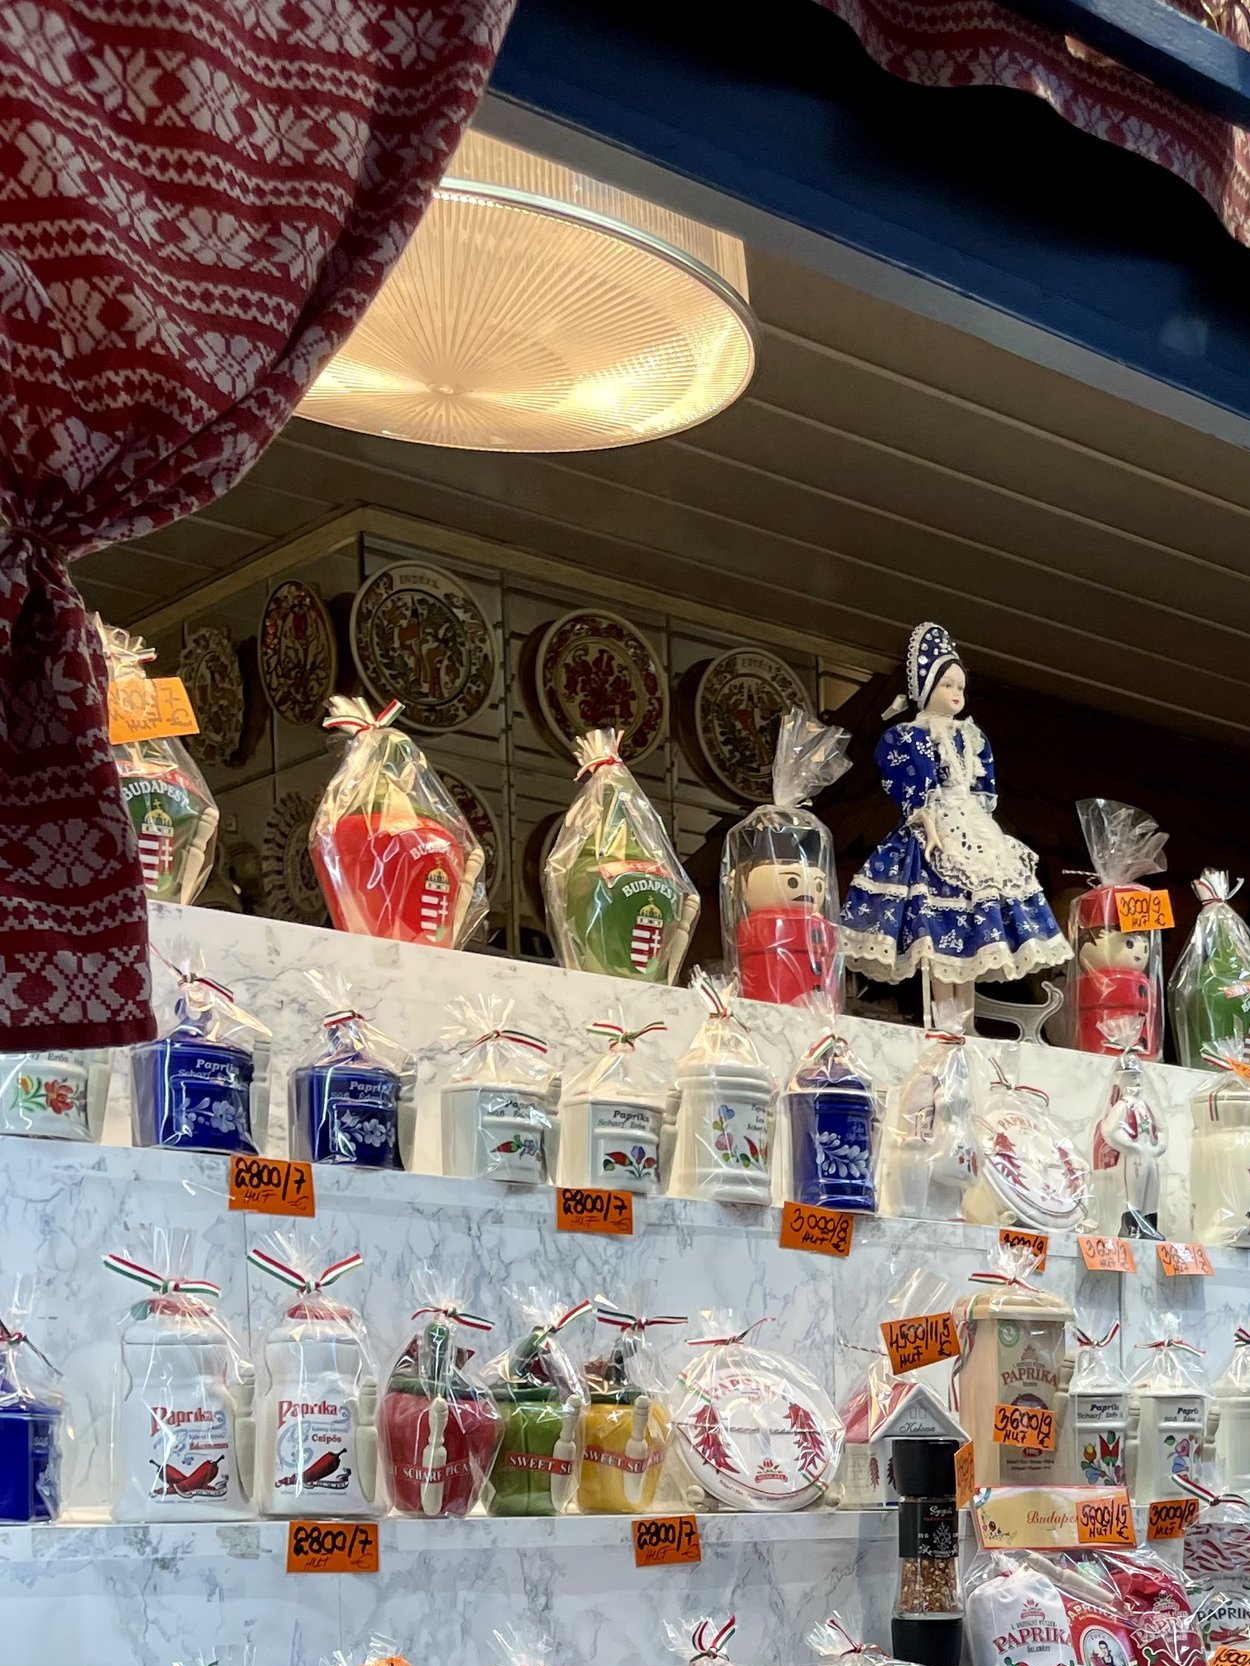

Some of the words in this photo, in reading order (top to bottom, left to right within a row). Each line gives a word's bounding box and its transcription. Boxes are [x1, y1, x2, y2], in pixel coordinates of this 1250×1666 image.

[612, 1109, 650, 1124] Paprika
[234, 1157, 306, 1200] 2800/7
[561, 1188, 629, 1221] 2800/7
[791, 1207, 849, 1242] 3000/8
[1002, 1370, 1059, 1387] PAPRIKA
[151, 1406, 214, 1436] Paprika
[278, 1400, 338, 1429] Paprika
[994, 1408, 1053, 1439] 3600/9
[510, 1456, 548, 1470] SWEET
[1080, 1503, 1128, 1533] 5600/15
[1149, 1503, 1199, 1524] 3000/8
[294, 1525, 373, 1558] 2800/7
[637, 1520, 696, 1551] 2800/7
[992, 1626, 1072, 1654] PAPRIKA
